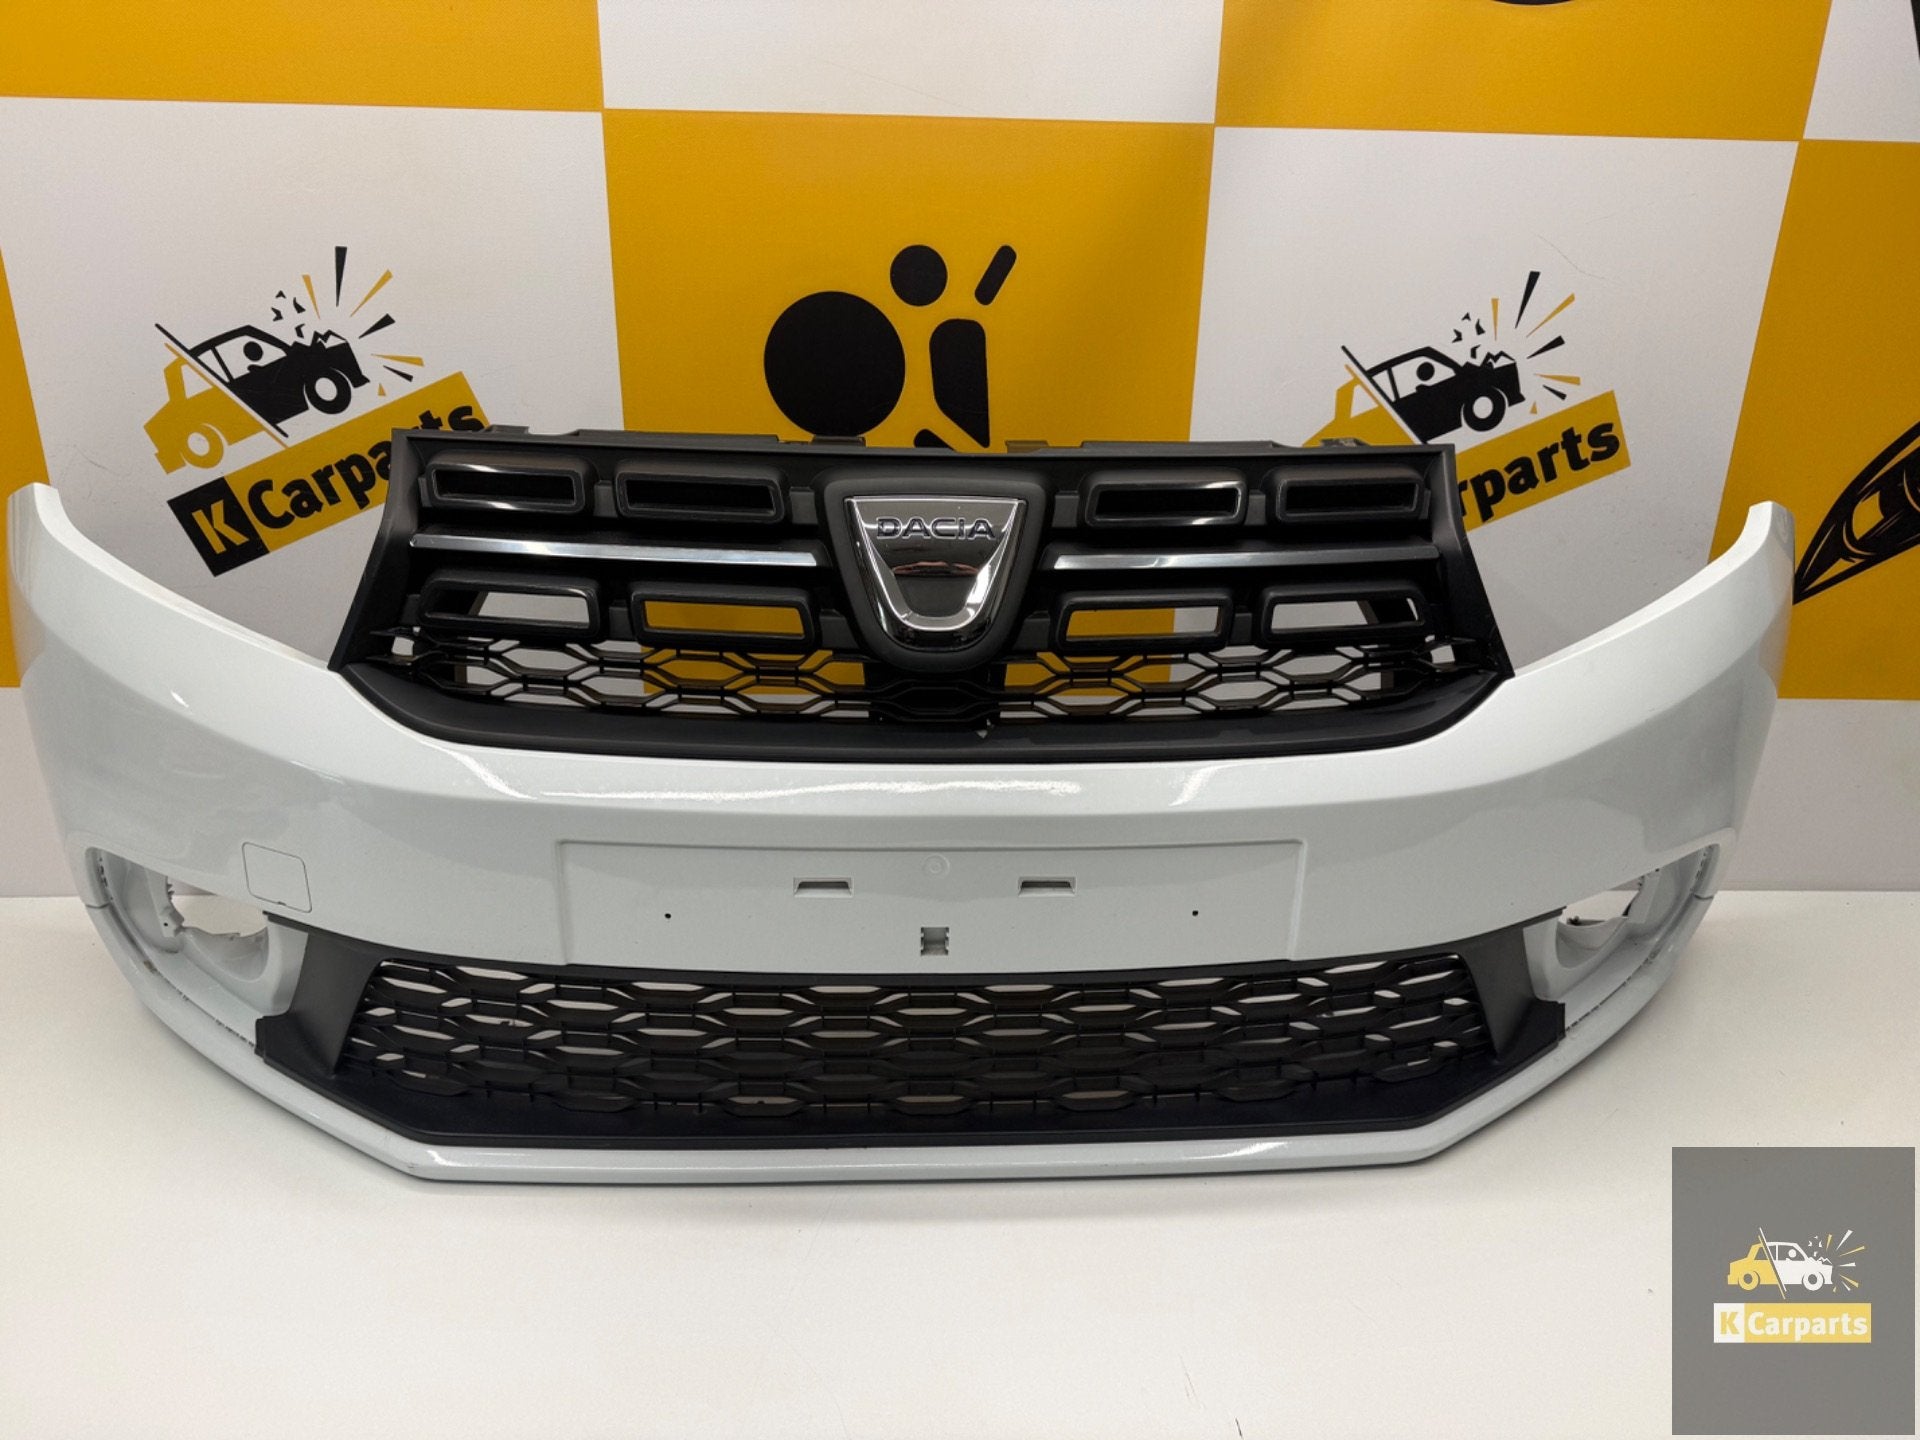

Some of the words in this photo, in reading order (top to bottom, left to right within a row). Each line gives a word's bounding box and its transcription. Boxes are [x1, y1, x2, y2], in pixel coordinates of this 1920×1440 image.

[192, 500, 249, 554] K
[248, 406, 484, 529] Carpas
[1458, 422, 1620, 523] rparts
[876, 517, 996, 540] DACIA
